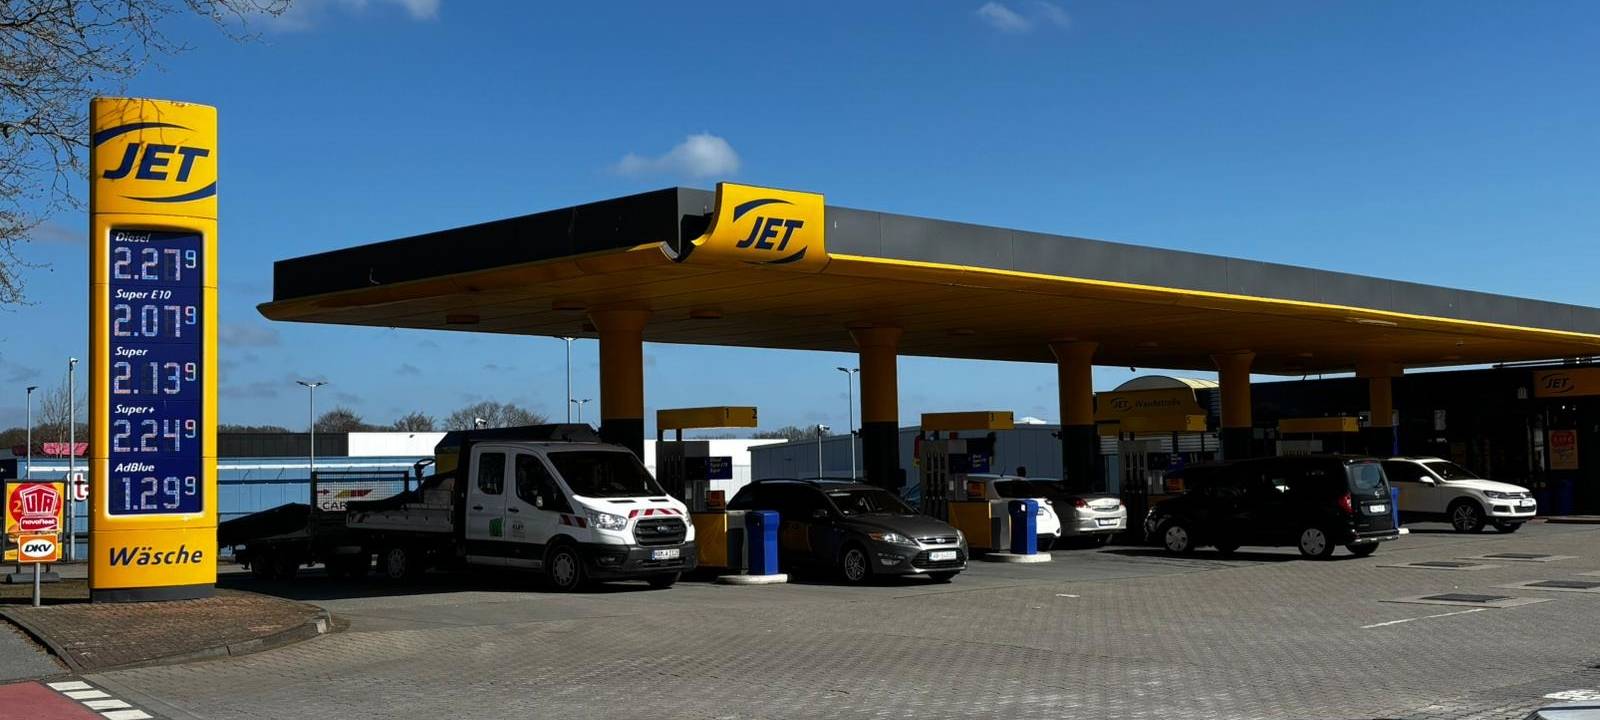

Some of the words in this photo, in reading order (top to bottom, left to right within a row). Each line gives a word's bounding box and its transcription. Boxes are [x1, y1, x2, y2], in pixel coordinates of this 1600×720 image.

[103, 142, 210, 183] JET
[115, 232, 151, 243] Diesel
[736, 216, 804, 252] JET
[115, 288, 149, 301] Super
[151, 290, 172, 300] E10
[115, 346, 149, 357] Super
[1545, 377, 1569, 389] JET
[115, 404, 156, 415] Super+
[115, 462, 156, 473] AdBlue
[25, 489, 54, 513] UTA
[24, 543, 52, 553] DKV
[109, 545, 203, 567] Wäsche
